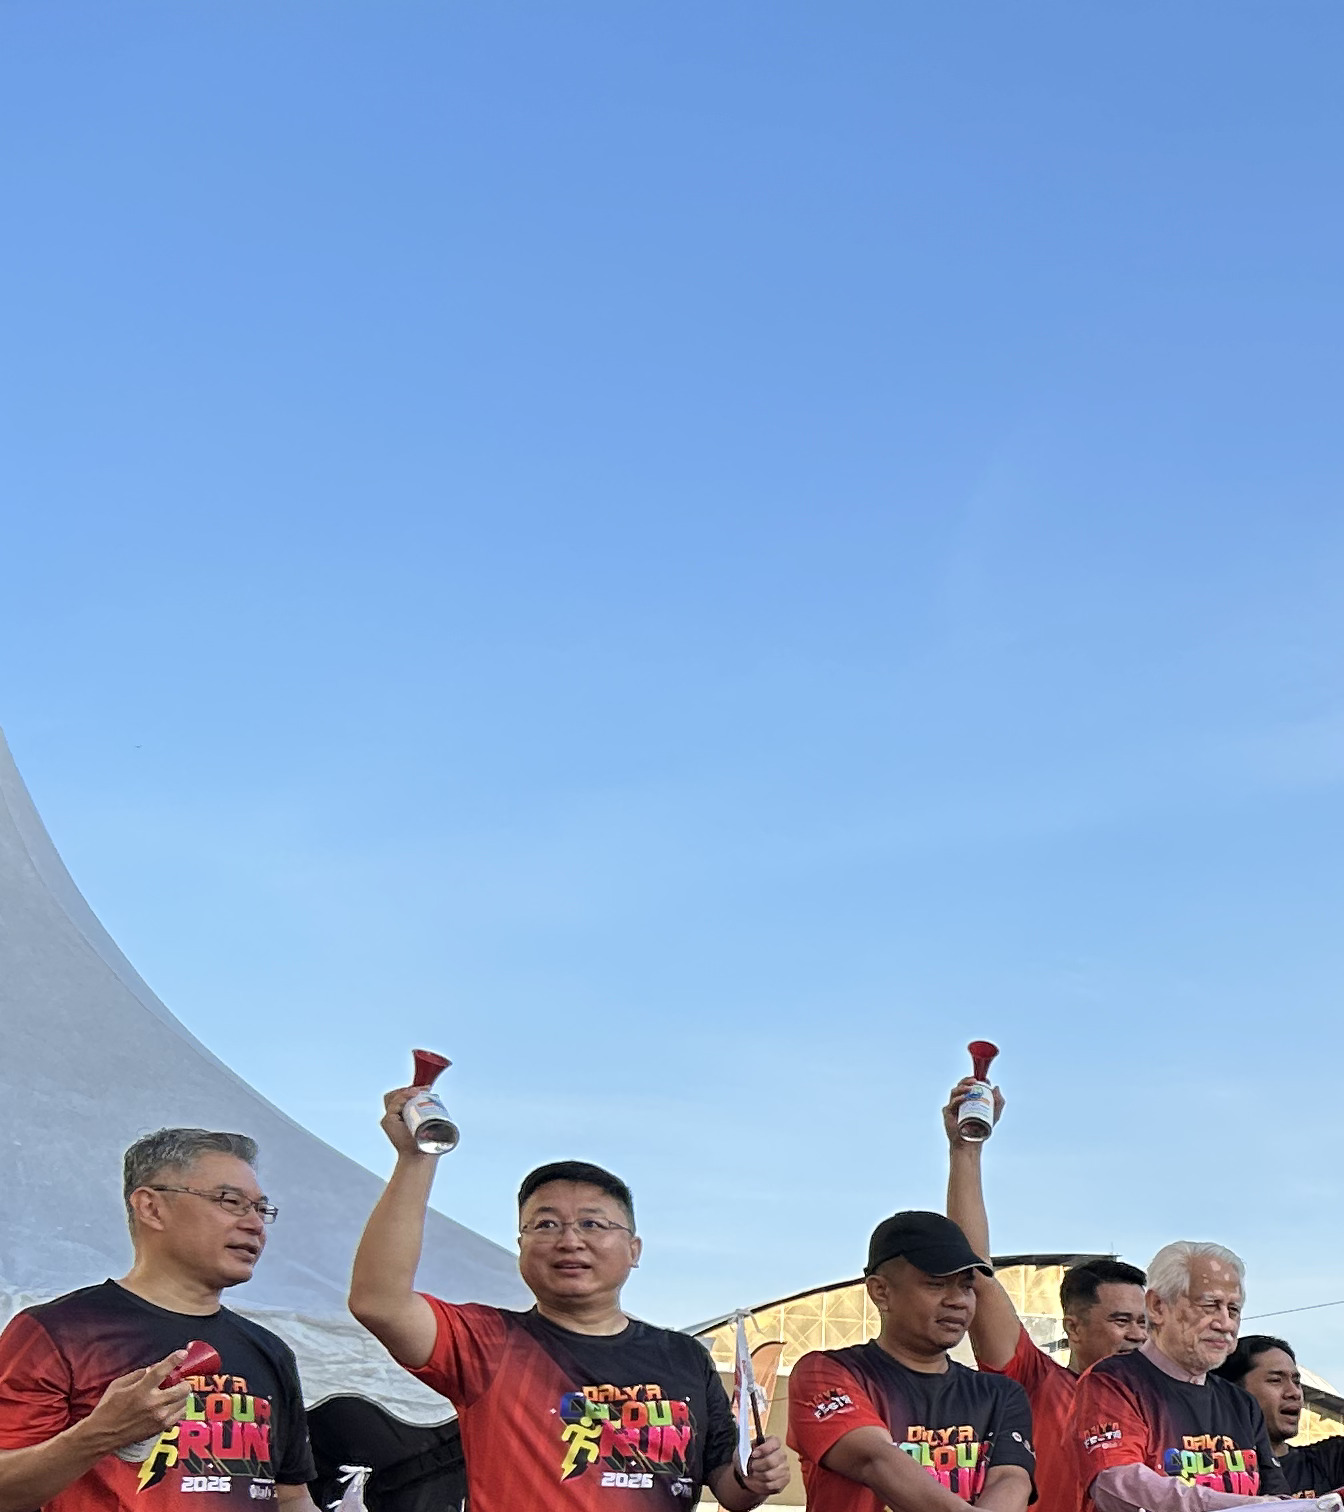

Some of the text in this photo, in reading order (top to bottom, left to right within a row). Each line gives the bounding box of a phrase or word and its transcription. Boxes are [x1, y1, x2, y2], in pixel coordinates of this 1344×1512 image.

[185, 1392, 272, 1422] LOUR
[178, 1420, 271, 1461] RUN
[180, 1476, 232, 1493] 2026
[601, 1472, 654, 1488] 2026
